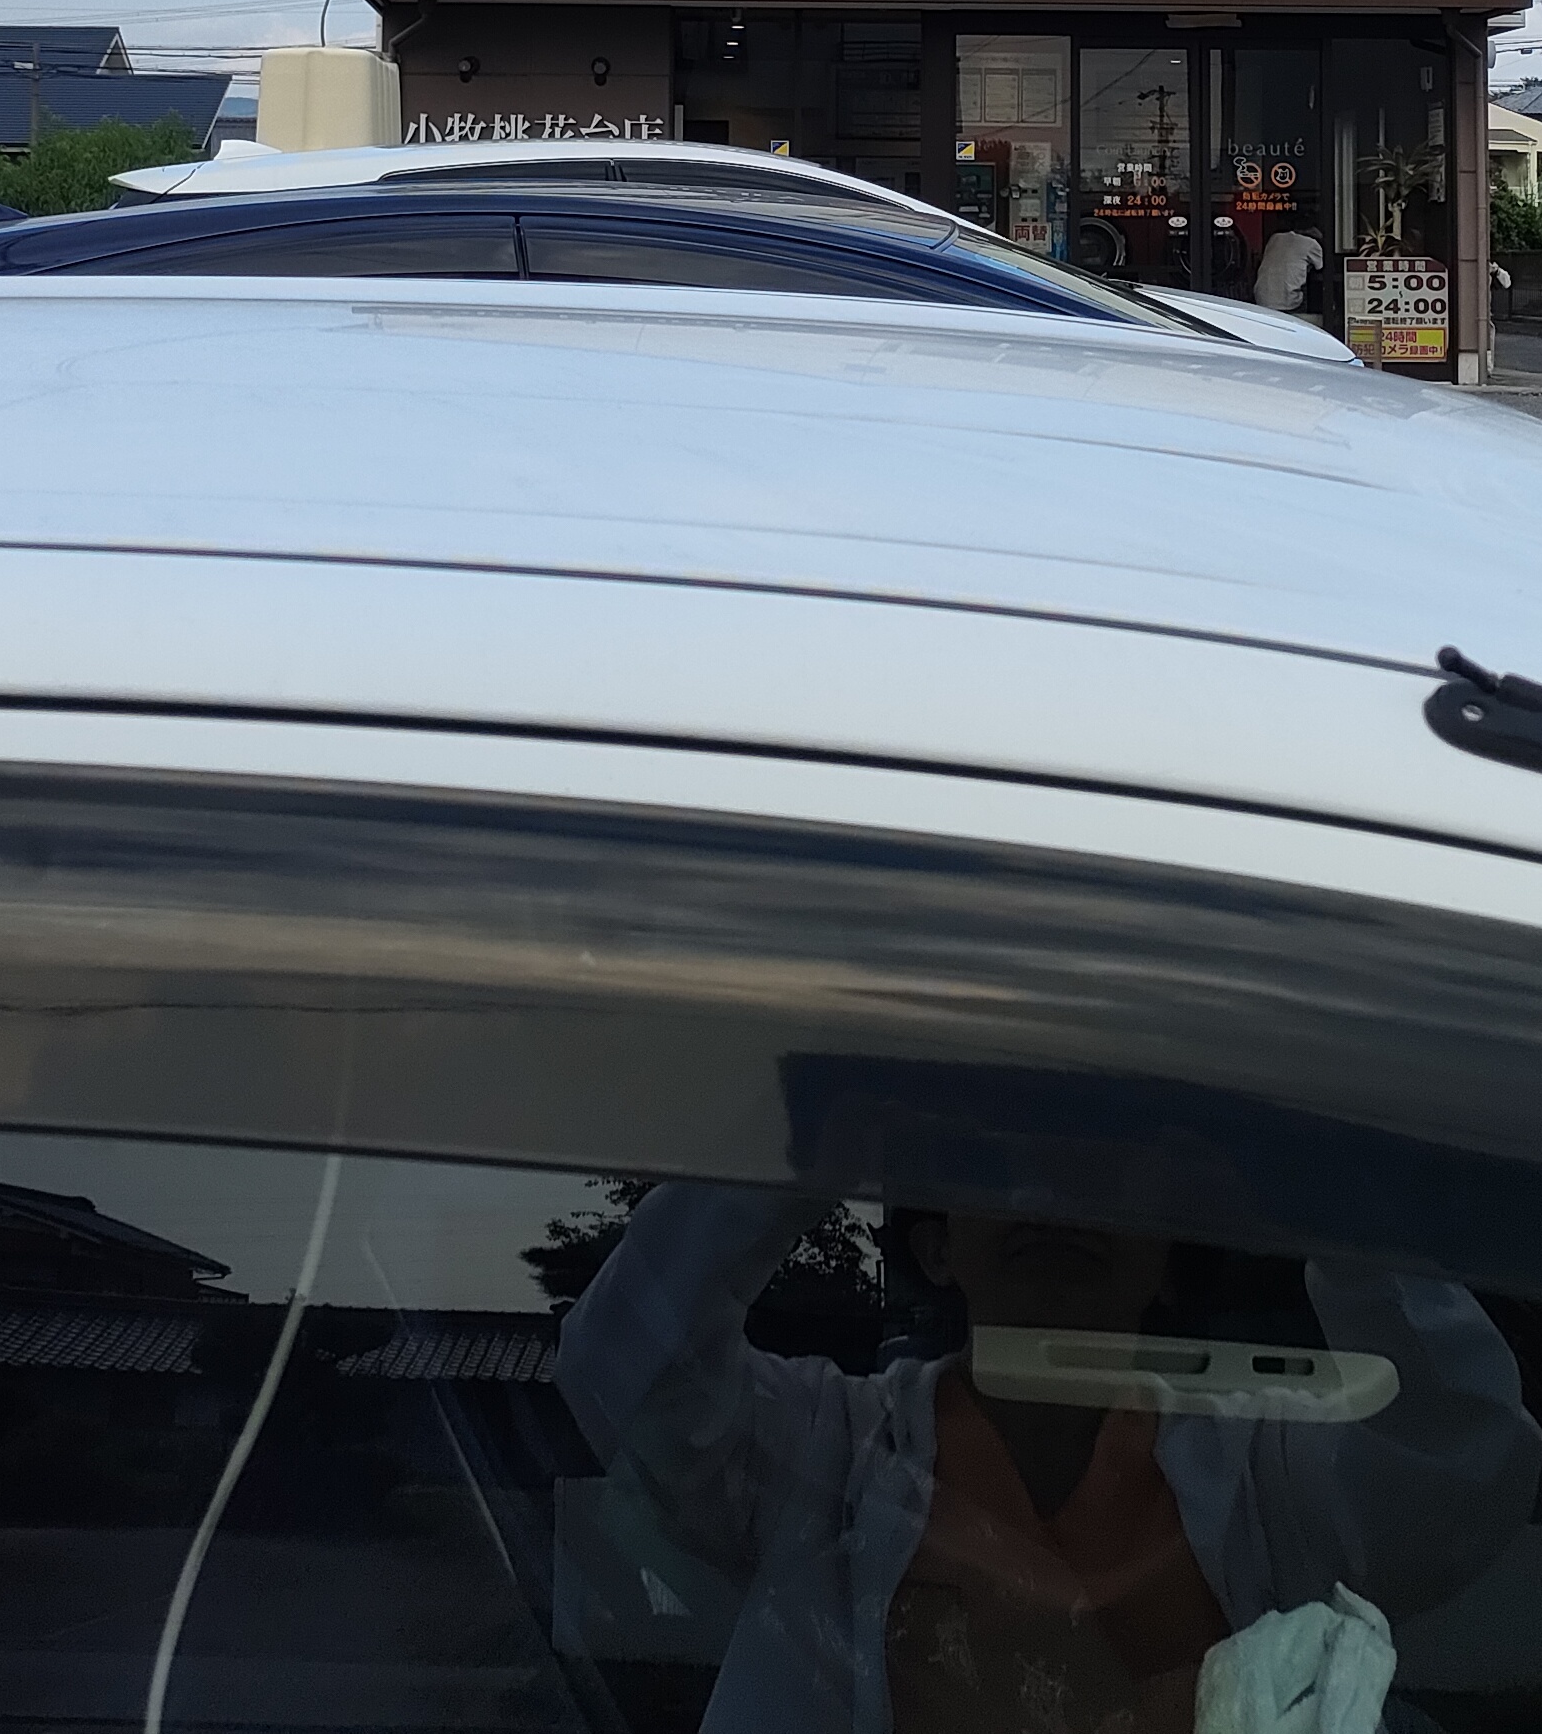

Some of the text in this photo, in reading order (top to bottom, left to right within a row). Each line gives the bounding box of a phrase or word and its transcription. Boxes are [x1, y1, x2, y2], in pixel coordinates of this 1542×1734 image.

[1227, 138, 1305, 157] beauté
[1014, 225, 1048, 242] 両替
[1366, 260, 1426, 272] 営業時間
[1367, 275, 1446, 291] 5:00
[1367, 298, 1447, 314] 24:00
